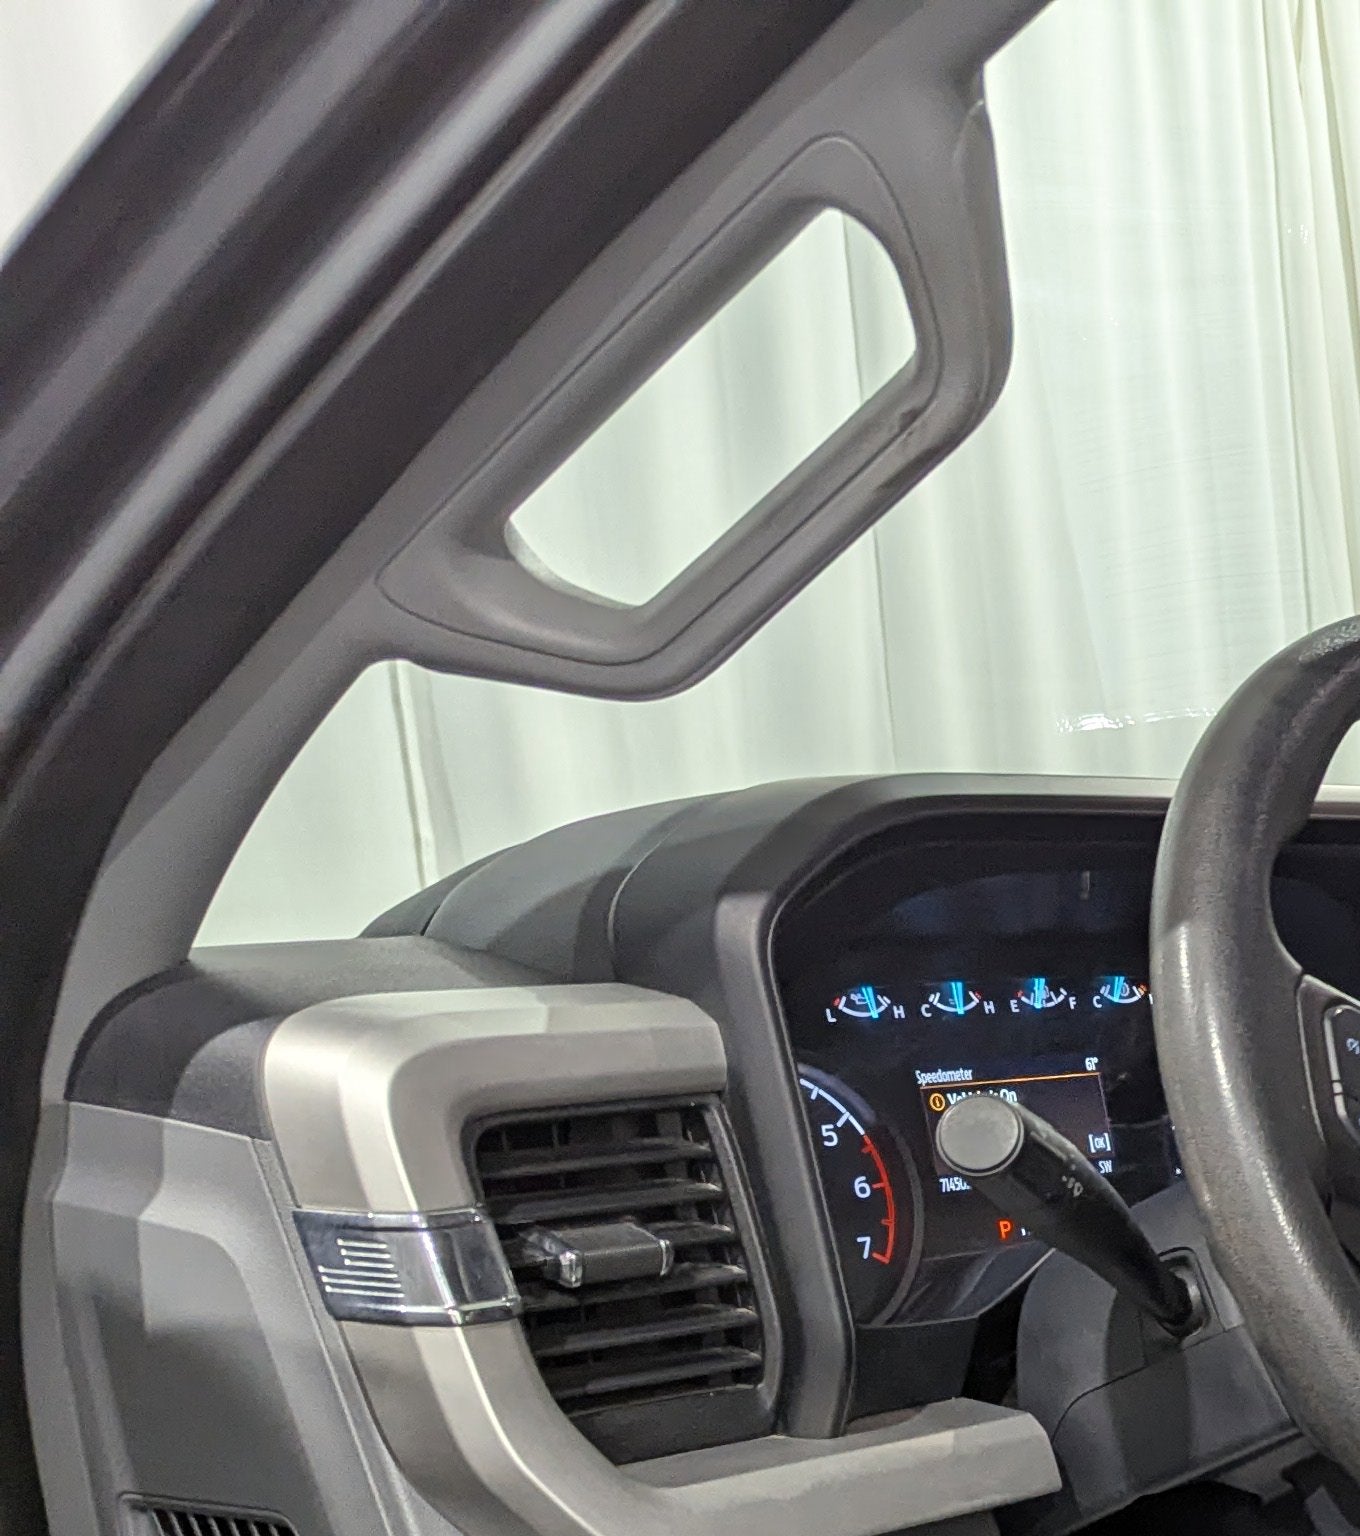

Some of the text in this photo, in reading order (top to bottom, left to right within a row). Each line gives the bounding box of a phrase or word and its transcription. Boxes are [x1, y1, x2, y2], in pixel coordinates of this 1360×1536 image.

[983, 1000, 995, 1014] H
[1010, 1000, 1020, 1012] E
[1069, 997, 1078, 1009] F
[1093, 996, 1102, 1008] C
[826, 1008, 837, 1022] L
[893, 1005, 905, 1019] H
[921, 1004, 932, 1017] C
[915, 1067, 973, 1086] Speedometer
[821, 1124, 838, 1147] 5
[854, 1176, 871, 1198] 6
[1000, 1221, 1012, 1240] P
[856, 1236, 871, 1260] 7
